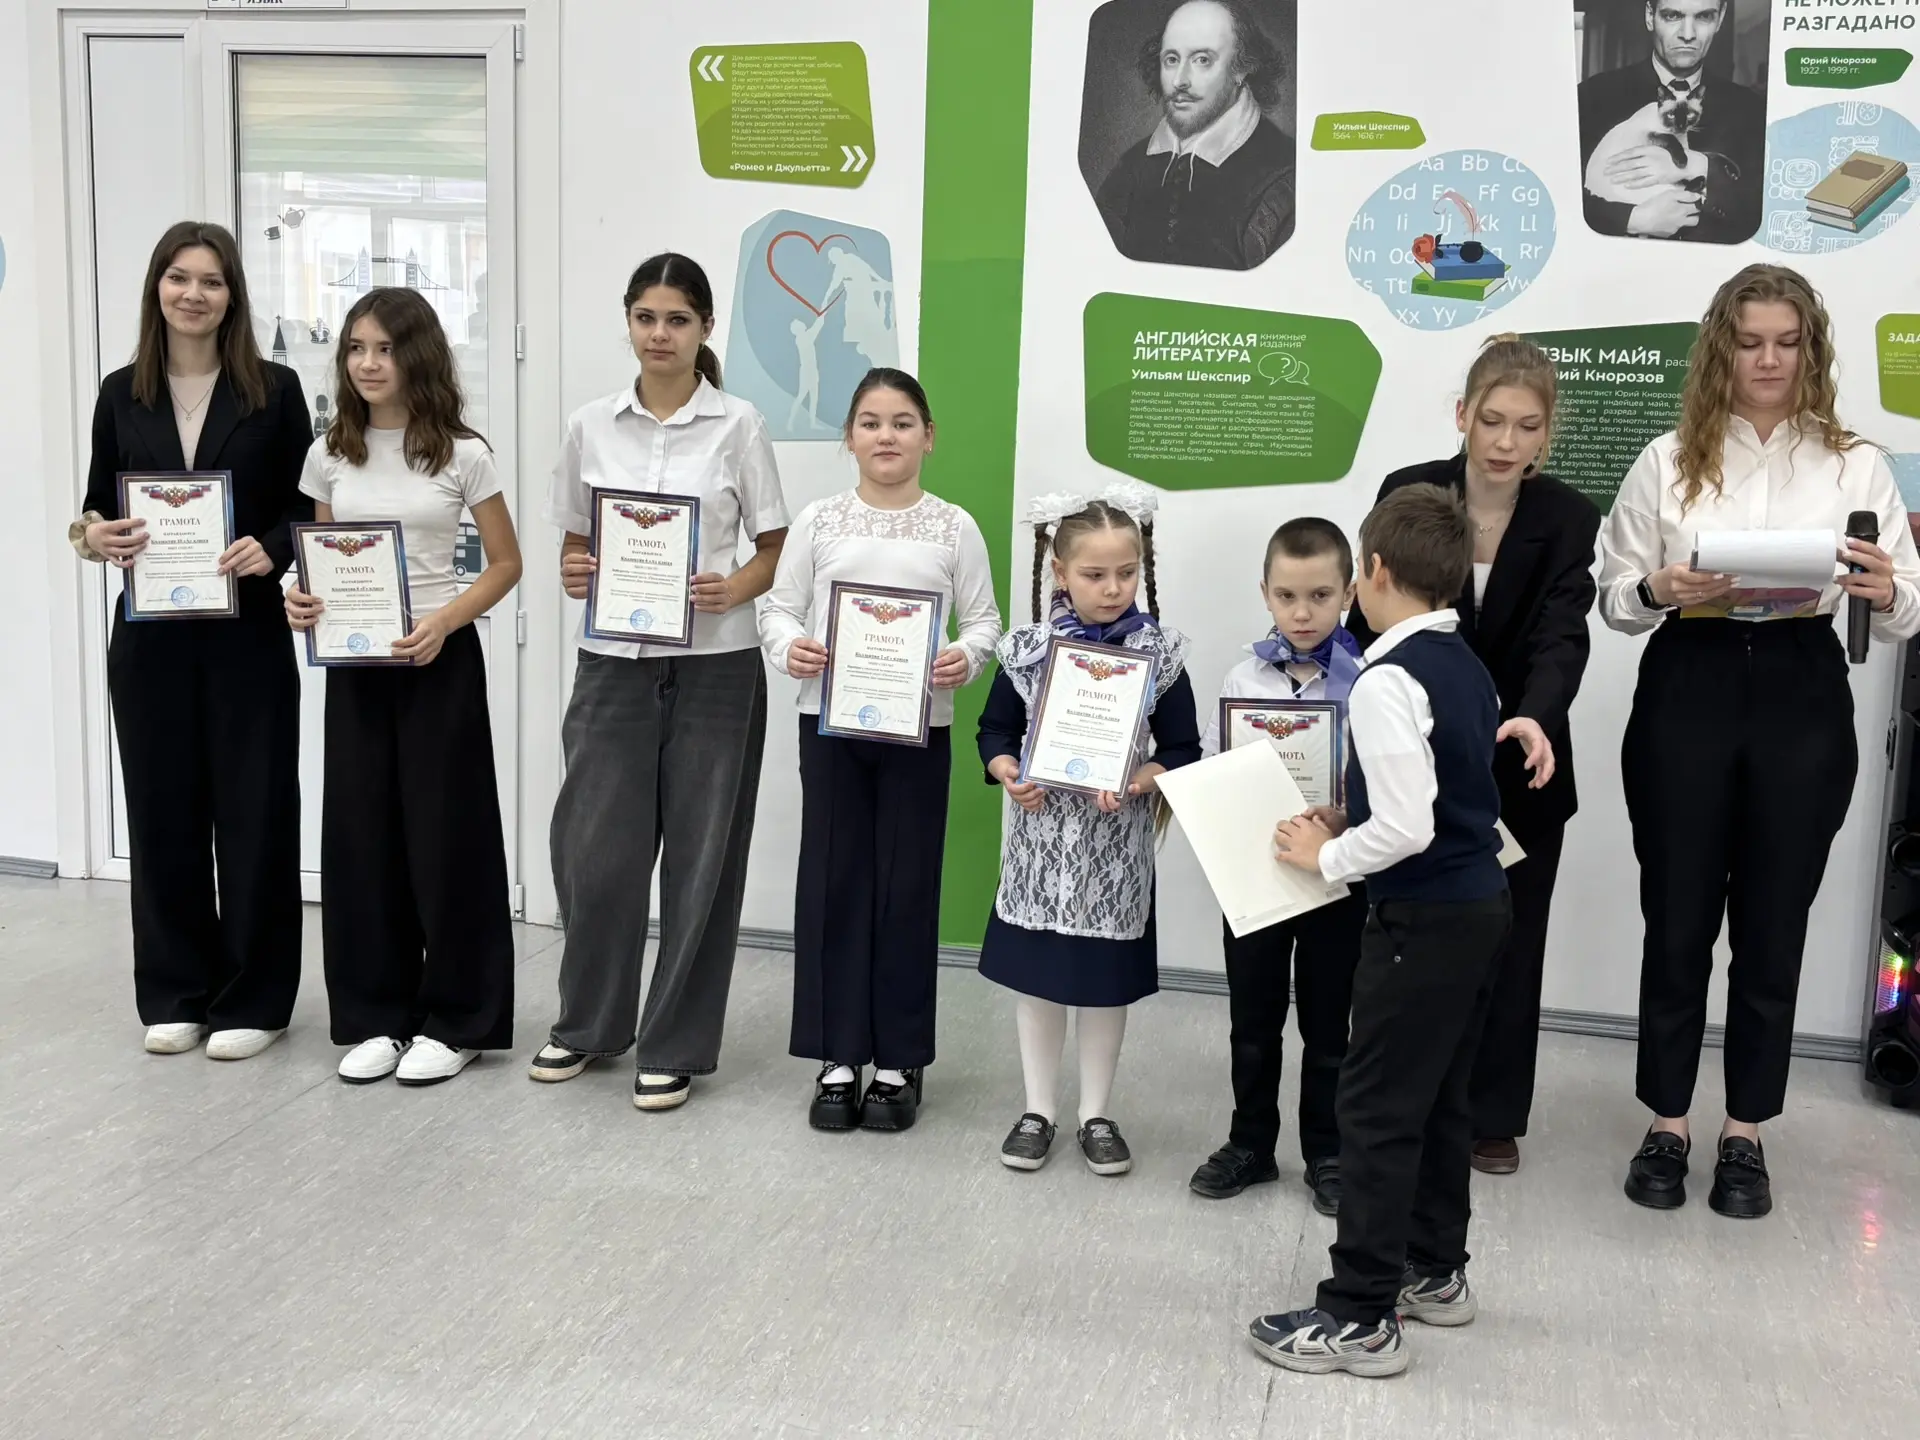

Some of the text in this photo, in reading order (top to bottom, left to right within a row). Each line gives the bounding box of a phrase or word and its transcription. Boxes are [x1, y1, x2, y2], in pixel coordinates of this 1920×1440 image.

[1783, 15, 1915, 33] РАЗГАДАНО
[1800, 57, 1877, 65] Юрий Кнорозов
[1369, 123, 1411, 132] Шекспир
[730, 163, 764, 172] «Ромео
[775, 163, 830, 173] Джульетта»
[1418, 156, 1444, 171] Aa
[1461, 154, 1489, 171] Bb
[1389, 182, 1417, 201] Dd
[1479, 183, 1500, 202] Ff
[1512, 186, 1540, 207] Gg
[1397, 213, 1408, 231] Ii
[1436, 213, 1452, 236] Jj
[1521, 214, 1537, 232] Ll
[1348, 246, 1376, 263] Nn
[1520, 243, 1543, 260] Rr
[1385, 277, 1407, 294] Tt
[1396, 306, 1495, 327] Xx Yy Z
[1133, 329, 1257, 347] АНГЛИЙСКАЯ
[1260, 333, 1307, 341] книжные
[1259, 341, 1302, 349] издания
[1133, 346, 1251, 363] ЛИТЕРАТУРА
[1598, 346, 1661, 366] МАЙЯ
[1131, 369, 1251, 385] Уильям Шекспир
[1585, 369, 1664, 384] Кнорозов
[160, 518, 200, 526] ГРАМОТА
[627, 538, 667, 549] ГРАМОТА
[335, 566, 375, 574] ГРАМОТА
[865, 633, 905, 645] ГРАМОТА
[1077, 689, 1117, 704] ГРАМОТА
[1278, 751, 1305, 760] МОТА
